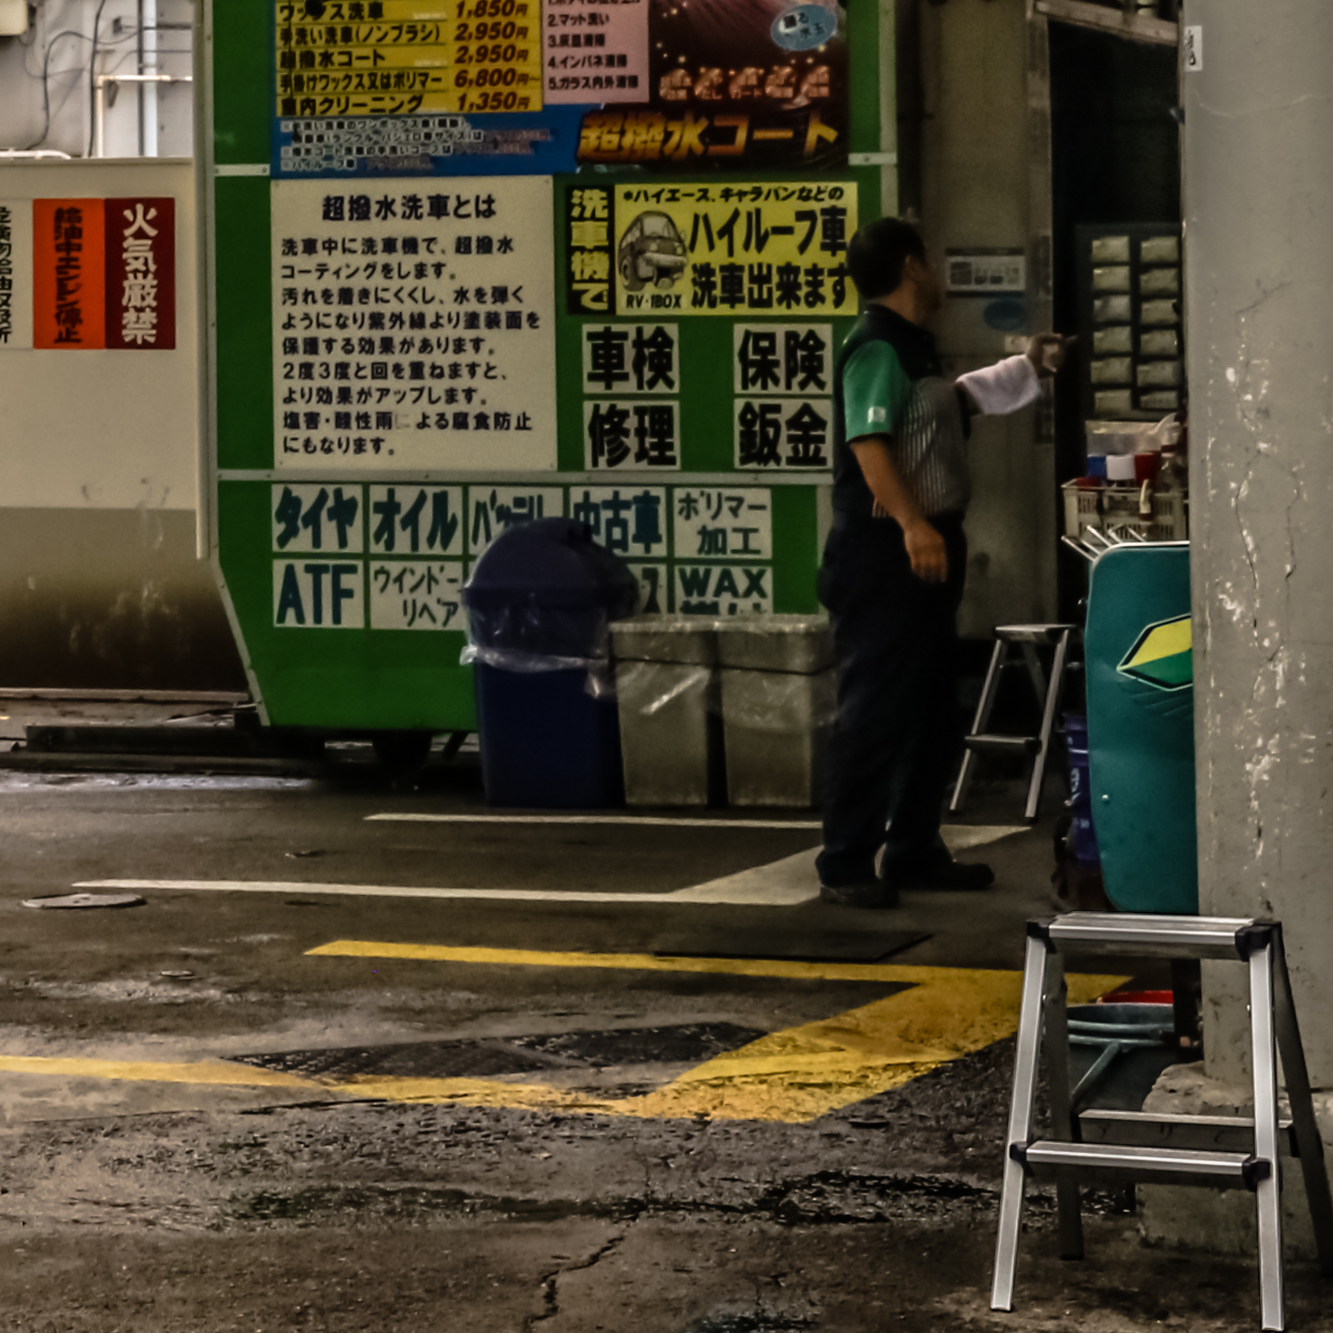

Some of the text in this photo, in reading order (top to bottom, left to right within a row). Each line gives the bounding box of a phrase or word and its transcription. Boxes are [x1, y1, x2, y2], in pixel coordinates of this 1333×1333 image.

[454, 21, 528, 42] 2,950円
[457, 0, 528, 18] 1,850円
[455, 44, 528, 64] 2,950円
[458, 92, 530, 112] 1,350円
[577, 111, 838, 163] 超撥水コート
[322, 194, 496, 221] 超撥水洗車とは
[689, 205, 847, 257] ハイルーフ車
[281, 262, 456, 280] コーティングをします。
[570, 188, 610, 312] 洗車機で
[53, 207, 83, 344] 給油中エンジン停止
[122, 203, 159, 345] 火気厳禁
[691, 262, 850, 309] 洗車出来ます
[282, 310, 541, 330] ようになり紫外線より塗装面を
[282, 336, 495, 356] 保護する効果があります。
[587, 326, 675, 391] 車検
[738, 329, 826, 391] 保険
[283, 386, 487, 405] より効果がアップします。
[283, 436, 395, 456] にもなります。
[588, 403, 676, 468] 修理
[739, 402, 828, 467] 鈑金
[277, 487, 358, 550] タイヤ
[374, 488, 458, 552] オイル
[698, 525, 761, 555] 加工
[277, 564, 355, 624] ATF
[679, 569, 767, 598] WAX
